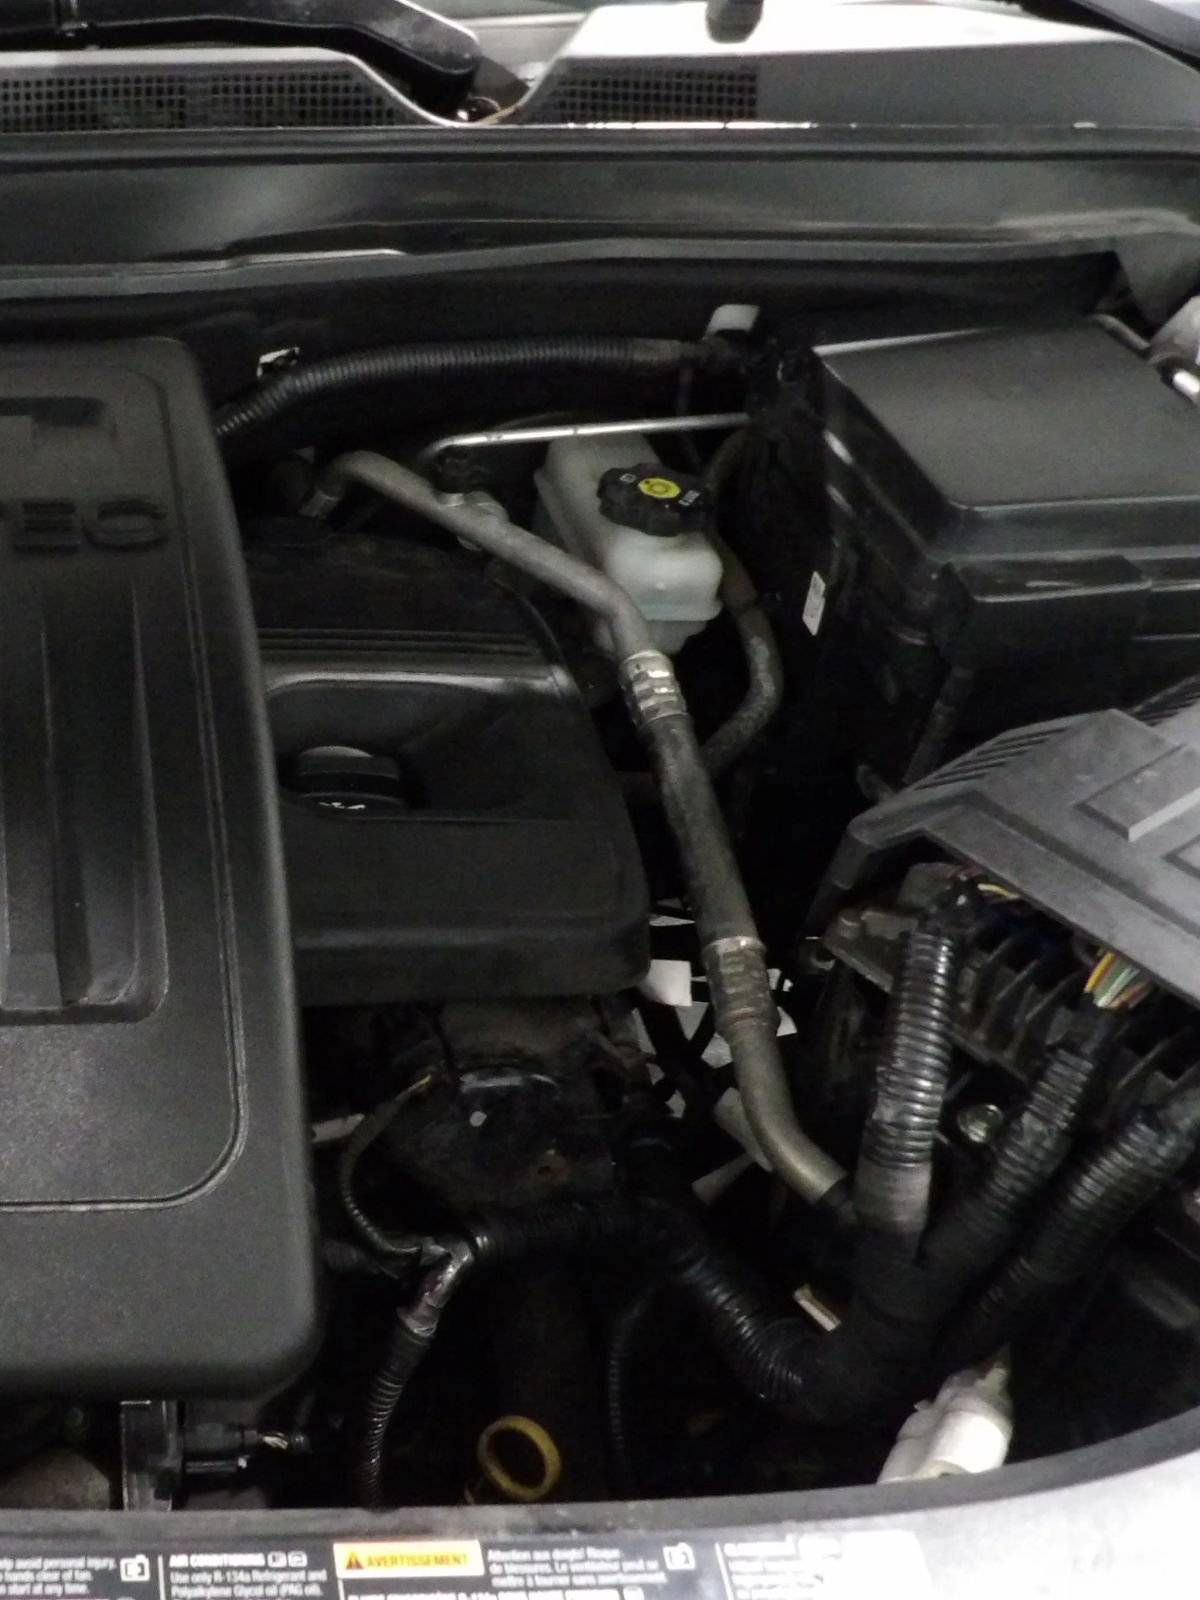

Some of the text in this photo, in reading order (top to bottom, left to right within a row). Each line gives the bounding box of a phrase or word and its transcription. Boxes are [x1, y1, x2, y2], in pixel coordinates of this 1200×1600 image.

[366, 1553, 468, 1569] AVERTISSEMENT
[170, 1571, 190, 1584] Use
[191, 1570, 212, 1585] only
[307, 1568, 328, 1582] and
